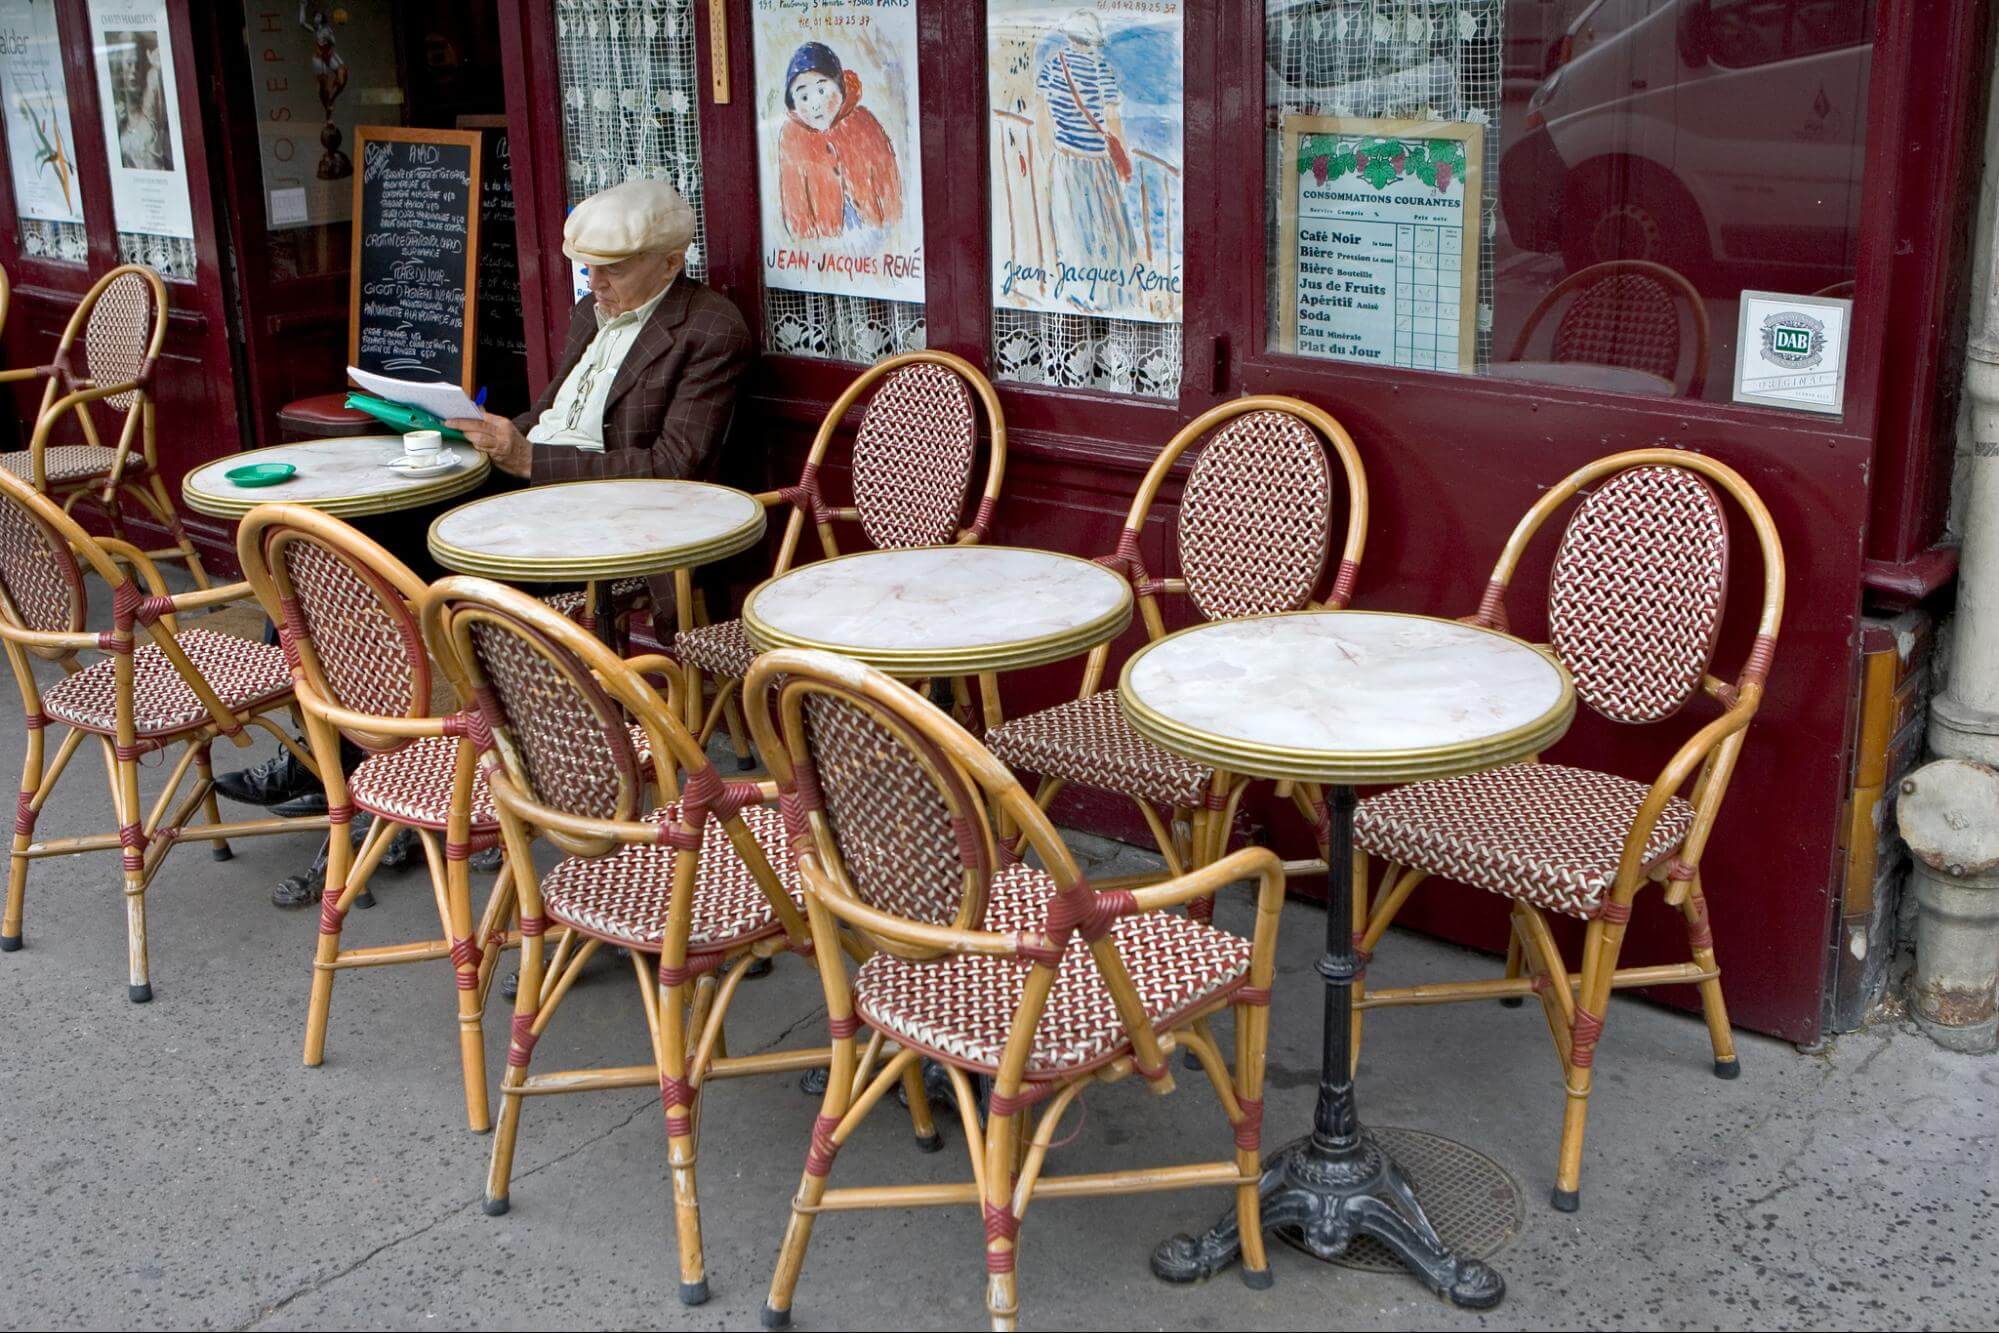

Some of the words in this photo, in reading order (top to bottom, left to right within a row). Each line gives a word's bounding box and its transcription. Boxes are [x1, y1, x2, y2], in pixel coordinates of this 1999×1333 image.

[259, 13, 301, 185] JOSEPH
[1303, 190, 1391, 204] CONSOMMATIONS
[1394, 196, 1461, 208] COURANTES
[1337, 209, 1364, 217] Compris
[1300, 229, 1328, 242] Café
[1332, 231, 1361, 244] Noir
[1300, 245, 1334, 259] Bière
[1337, 252, 1371, 263] Pression
[883, 247, 921, 279] RENÉ
[1300, 262, 1334, 275] Bière
[1337, 269, 1372, 279] Bouteille
[1128, 263, 1181, 294] René
[1300, 278, 1323, 290] Jus
[1326, 280, 1341, 291] de
[1345, 282, 1386, 295] Fruits
[1299, 293, 1353, 309] Apéritif
[1356, 302, 1379, 310] Anisé
[1299, 309, 1331, 321] Soda
[1299, 325, 1325, 338] Eau
[1327, 331, 1362, 341] Minérale
[1777, 332, 1808, 349] DAB
[1300, 341, 1326, 353] Plat
[1328, 344, 1346, 355] du
[1349, 345, 1381, 358] Jour
